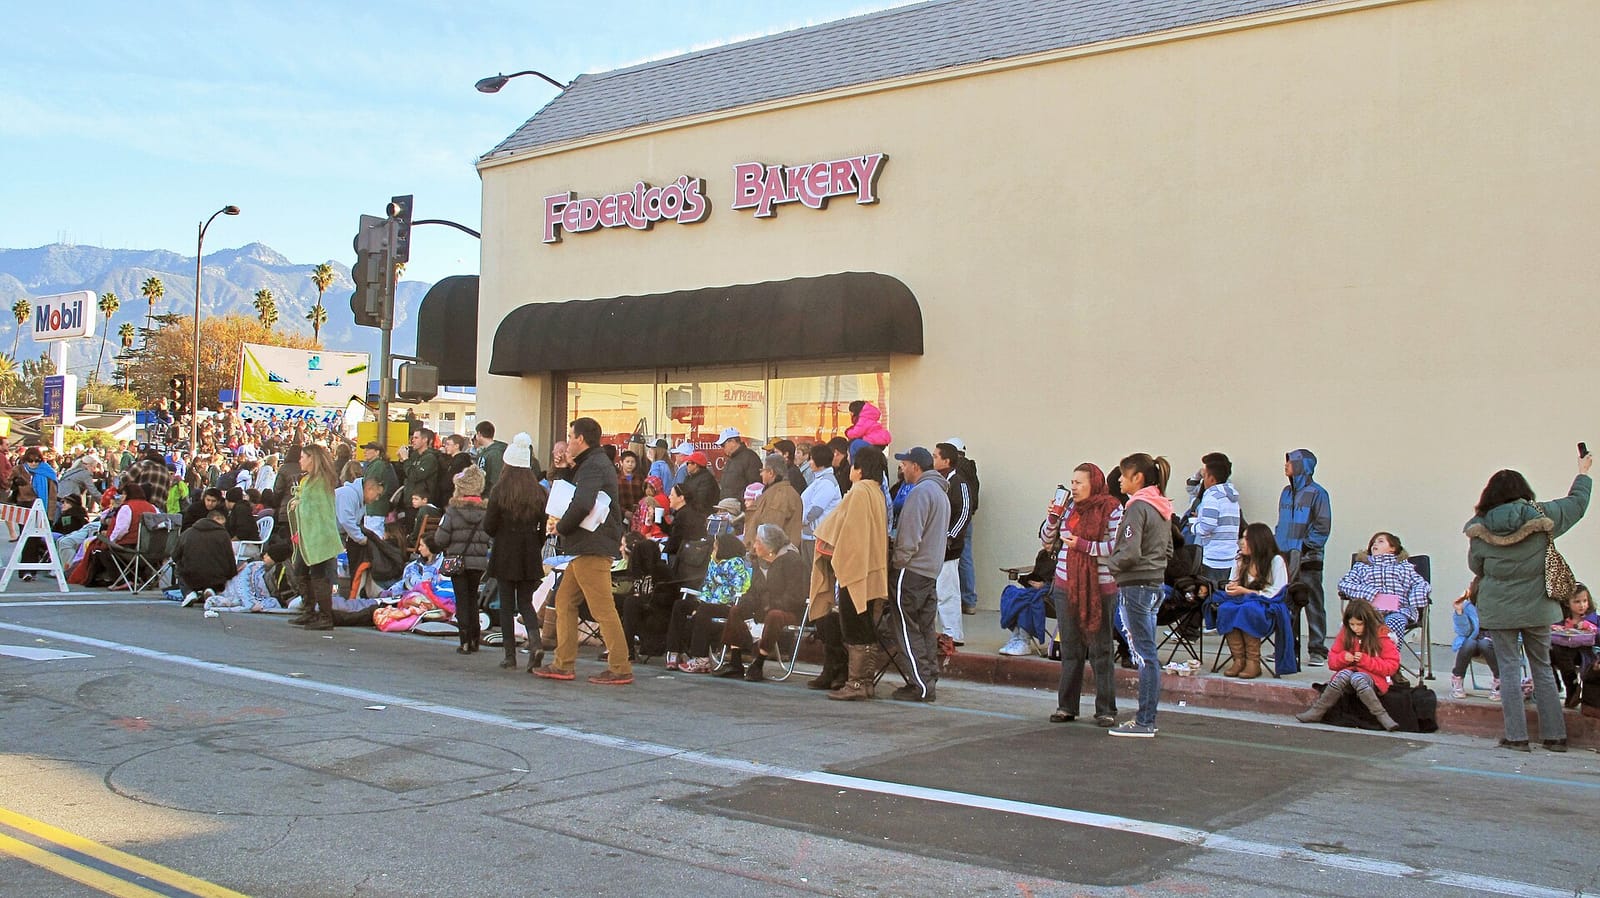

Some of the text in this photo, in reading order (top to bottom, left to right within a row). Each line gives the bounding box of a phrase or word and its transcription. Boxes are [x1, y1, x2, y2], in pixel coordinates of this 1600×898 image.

[543, 153, 885, 243] FEDERICO'S BAKERY
[35, 301, 82, 332] Mobil
[675, 437, 722, 450] Cistmas
